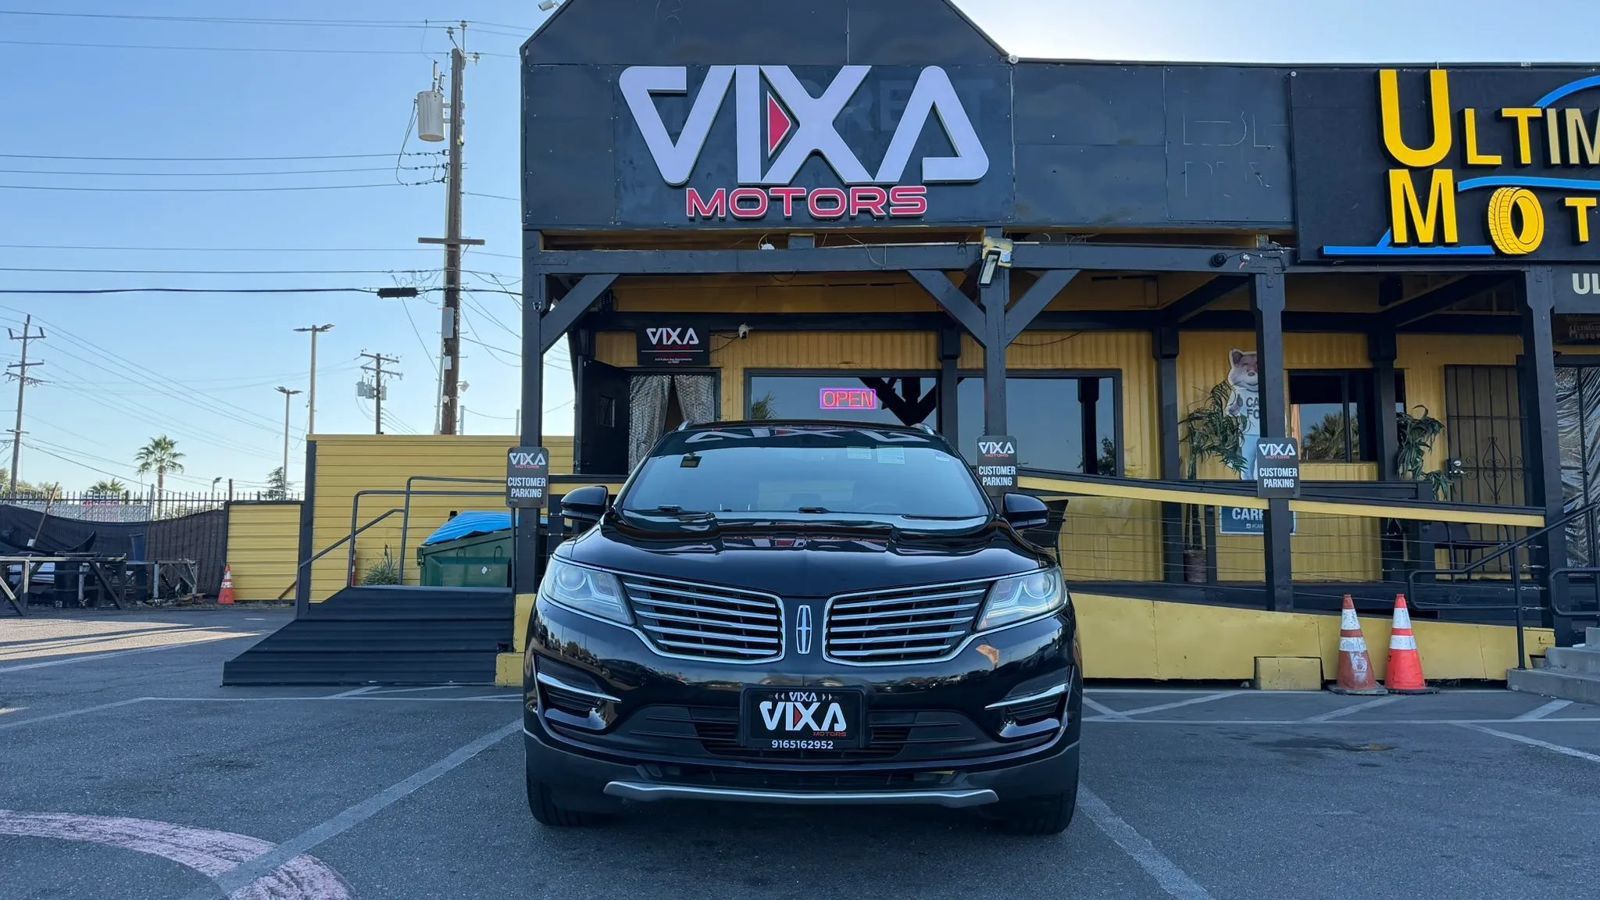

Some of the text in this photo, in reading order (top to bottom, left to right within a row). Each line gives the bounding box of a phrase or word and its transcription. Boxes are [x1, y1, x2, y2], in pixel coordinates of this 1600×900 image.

[618, 64, 990, 186] VIXA
[685, 185, 928, 219] MOTORS
[645, 327, 700, 345] VIXA
[823, 390, 873, 407] OPEN
[978, 441, 1015, 454] VIXA
[1258, 443, 1296, 456] VIXA
[509, 452, 546, 465] VIXA
[978, 465, 1016, 476] CUSTOMER
[1259, 467, 1298, 477] CUSTOMER
[507, 477, 546, 487] CUSTOMER
[982, 476, 1013, 486] PARKING
[1263, 478, 1294, 488] PARKING
[511, 488, 542, 498] PARKING
[788, 691, 818, 702] VIXA
[759, 702, 847, 731] VIXA
[771, 739, 834, 750] 9165162952
